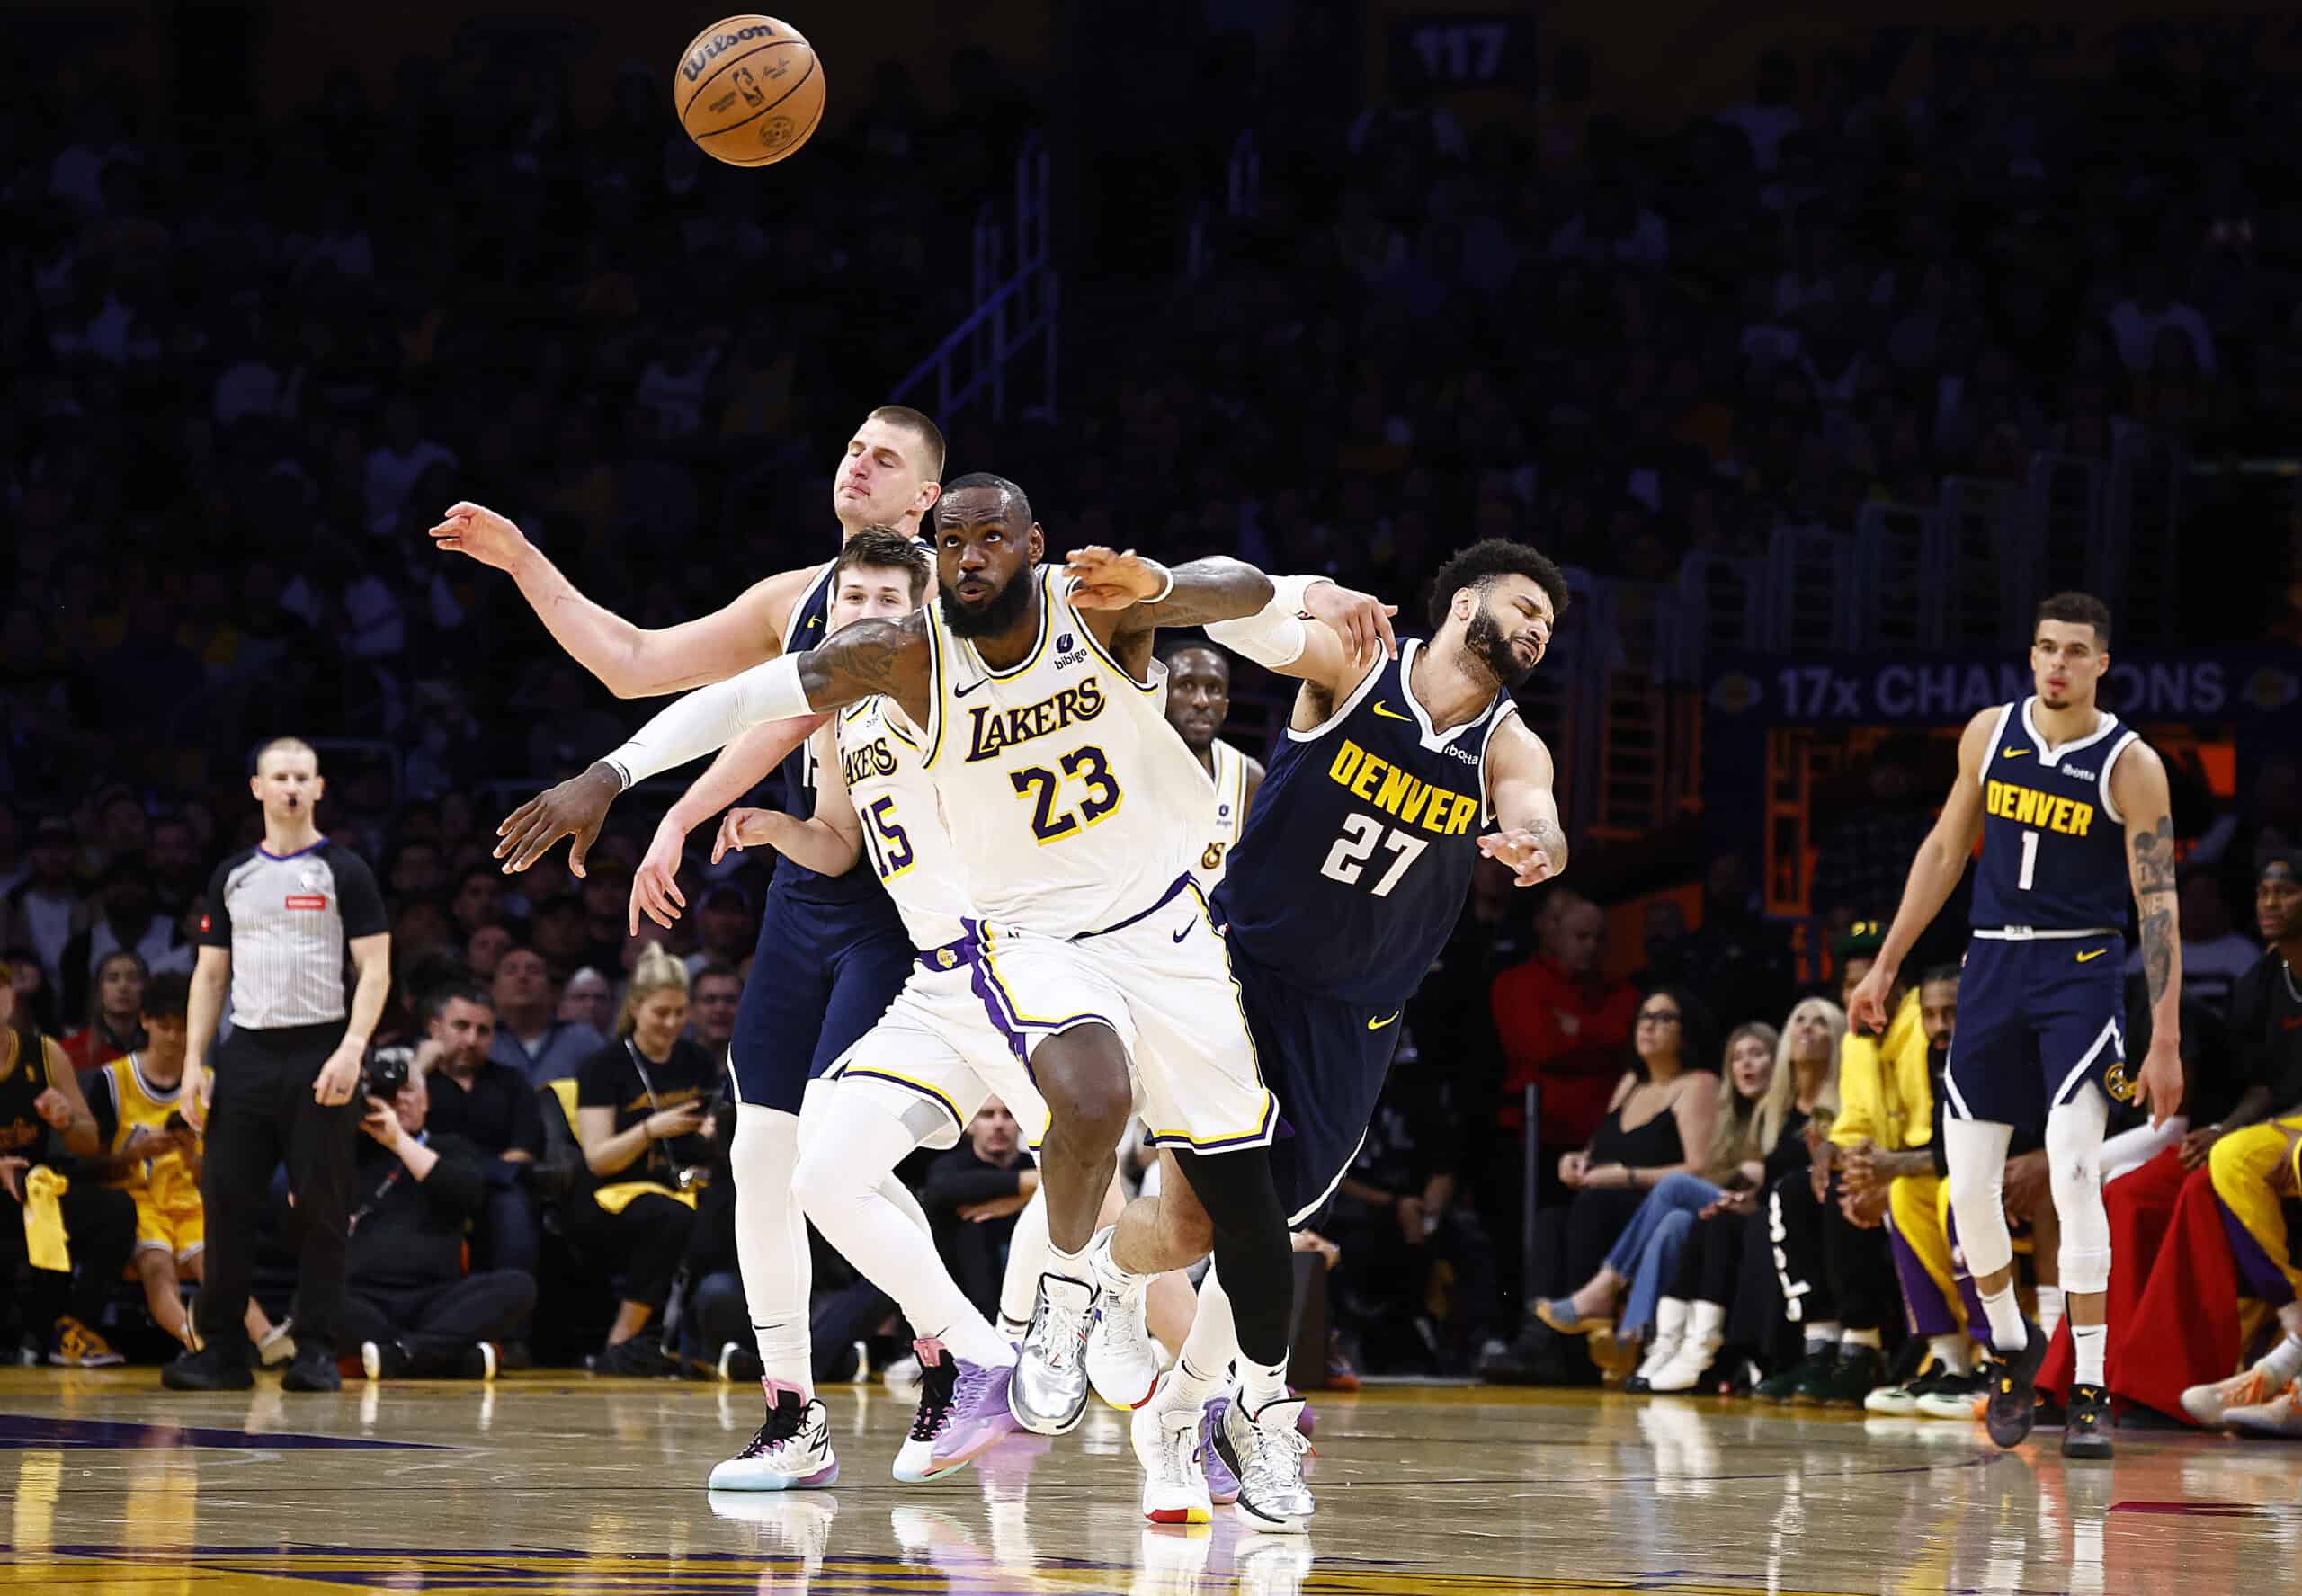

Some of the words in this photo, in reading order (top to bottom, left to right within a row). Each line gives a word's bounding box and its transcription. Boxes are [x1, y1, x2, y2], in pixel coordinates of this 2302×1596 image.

[683, 24, 775, 82] Wilson
[1410, 24, 1511, 80] 117
[1055, 648, 1088, 670] bibigo
[1778, 665, 1863, 718] 17x
[1874, 661, 2228, 718] CHAMONS
[964, 676, 1107, 763] LAKERS
[1007, 745, 1124, 847] 23
[1328, 738, 1479, 835] DENVER
[1986, 779, 2094, 837] DENVER
[861, 794, 916, 883] 15
[1320, 812, 1430, 897] 27
[2017, 829, 2040, 891] 1
